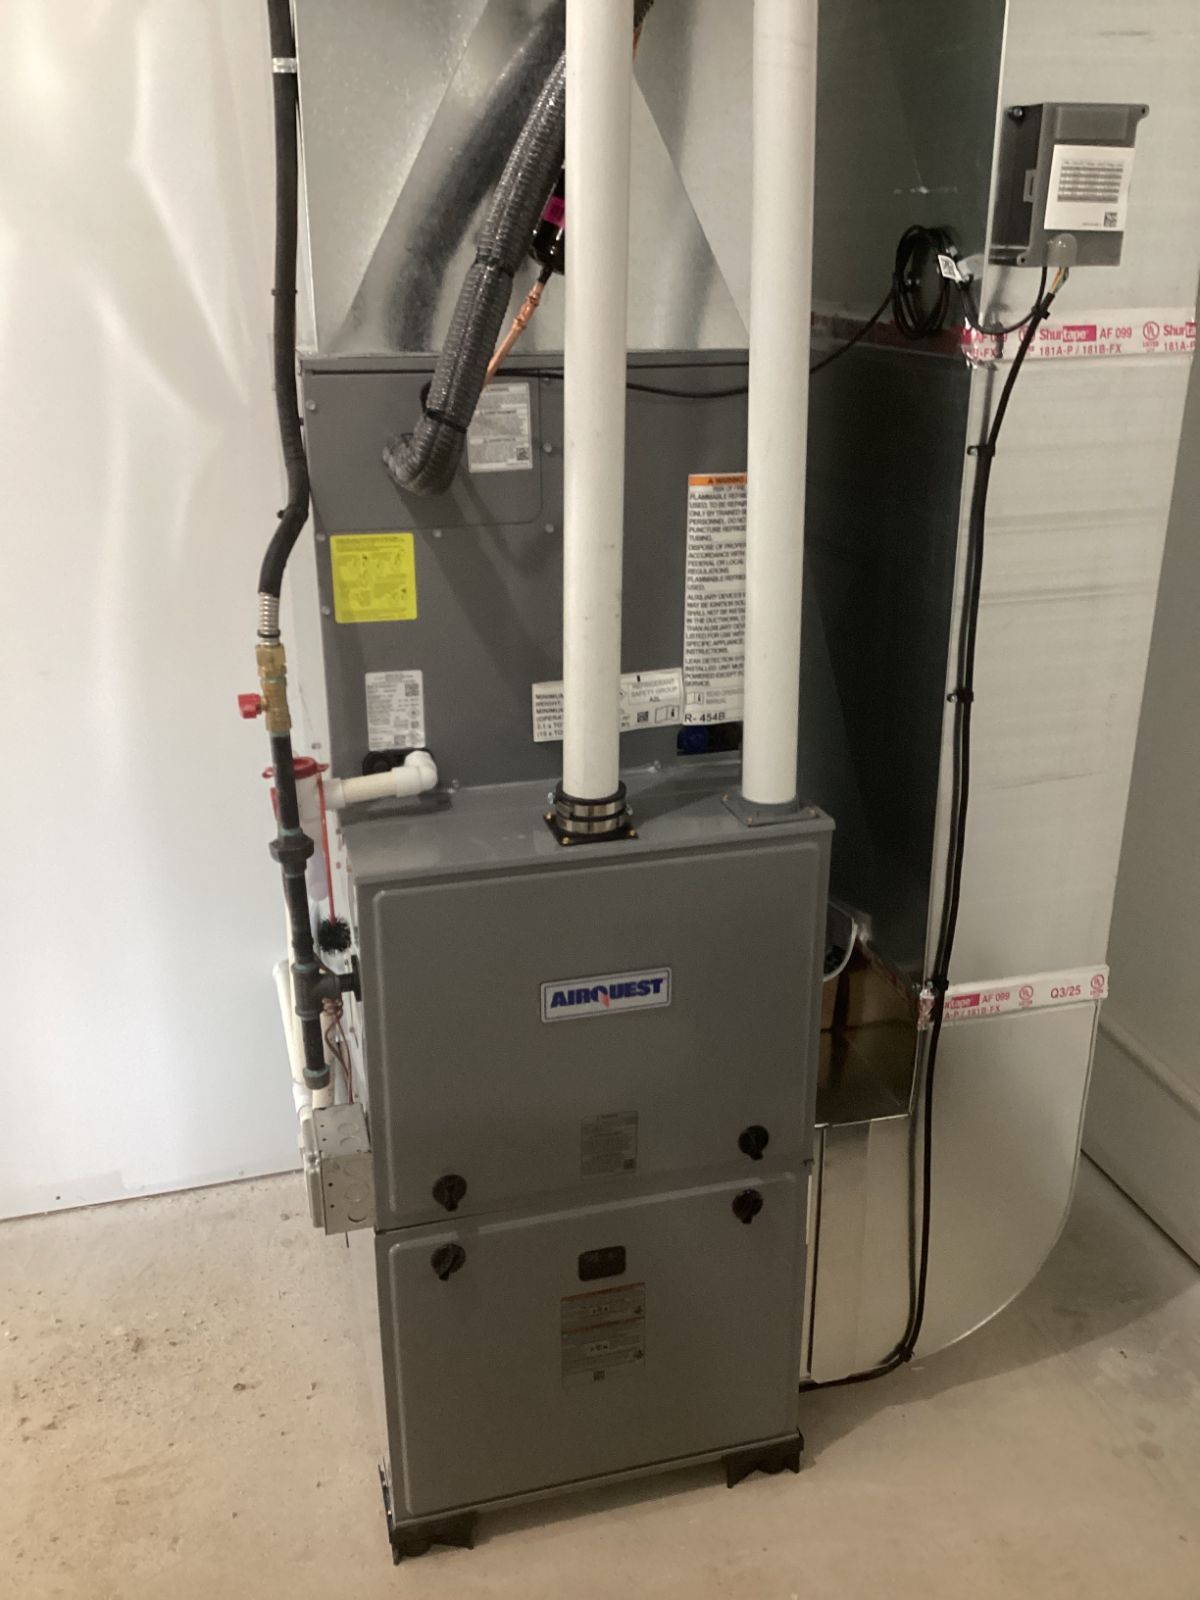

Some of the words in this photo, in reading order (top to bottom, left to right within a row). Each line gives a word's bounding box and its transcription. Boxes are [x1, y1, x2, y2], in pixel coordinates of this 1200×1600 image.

[1039, 327, 1089, 342] Shurtape
[1100, 327, 1113, 339] AF
[1115, 327, 1132, 339] 099
[1040, 345, 1073, 356] 181A-P
[1083, 343, 1122, 354] 181B-FX
[700, 712, 726, 722] 454B
[550, 977, 663, 1008] AIRQUEST
[1051, 985, 1082, 999] Q3/25
